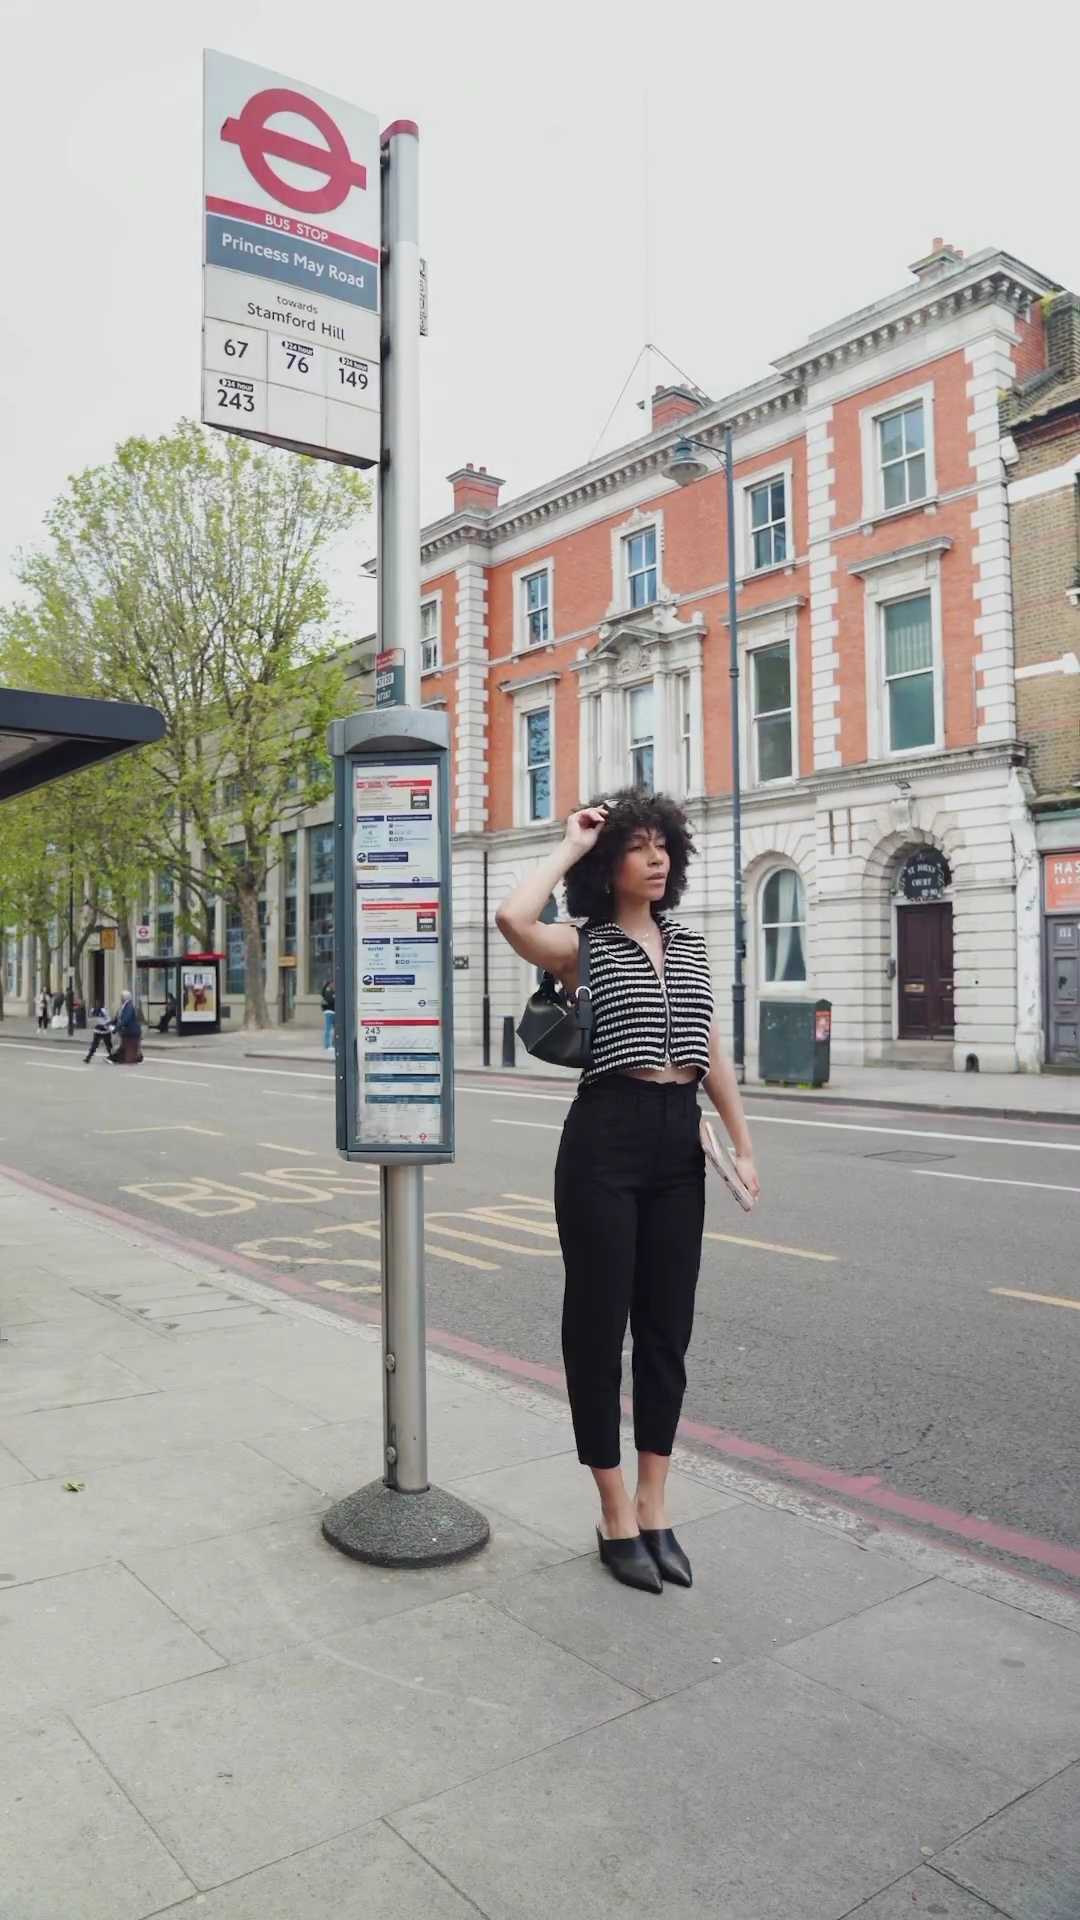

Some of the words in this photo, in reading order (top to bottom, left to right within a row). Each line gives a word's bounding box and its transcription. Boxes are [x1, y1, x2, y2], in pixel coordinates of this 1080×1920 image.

[265, 213, 291, 231] BUS
[296, 223, 329, 243] STOP
[222, 231, 289, 264] Princess
[294, 252, 324, 277] May
[329, 264, 364, 288] Road
[276, 295, 319, 315] towards
[247, 302, 316, 332] Stamford
[321, 322, 345, 341] Hill
[224, 339, 249, 359] 67
[286, 352, 310, 374] 76
[338, 368, 369, 391] 149
[217, 389, 255, 412] 243
[365, 1027, 381, 1035] 243
[118, 1166, 383, 1218] BUS
